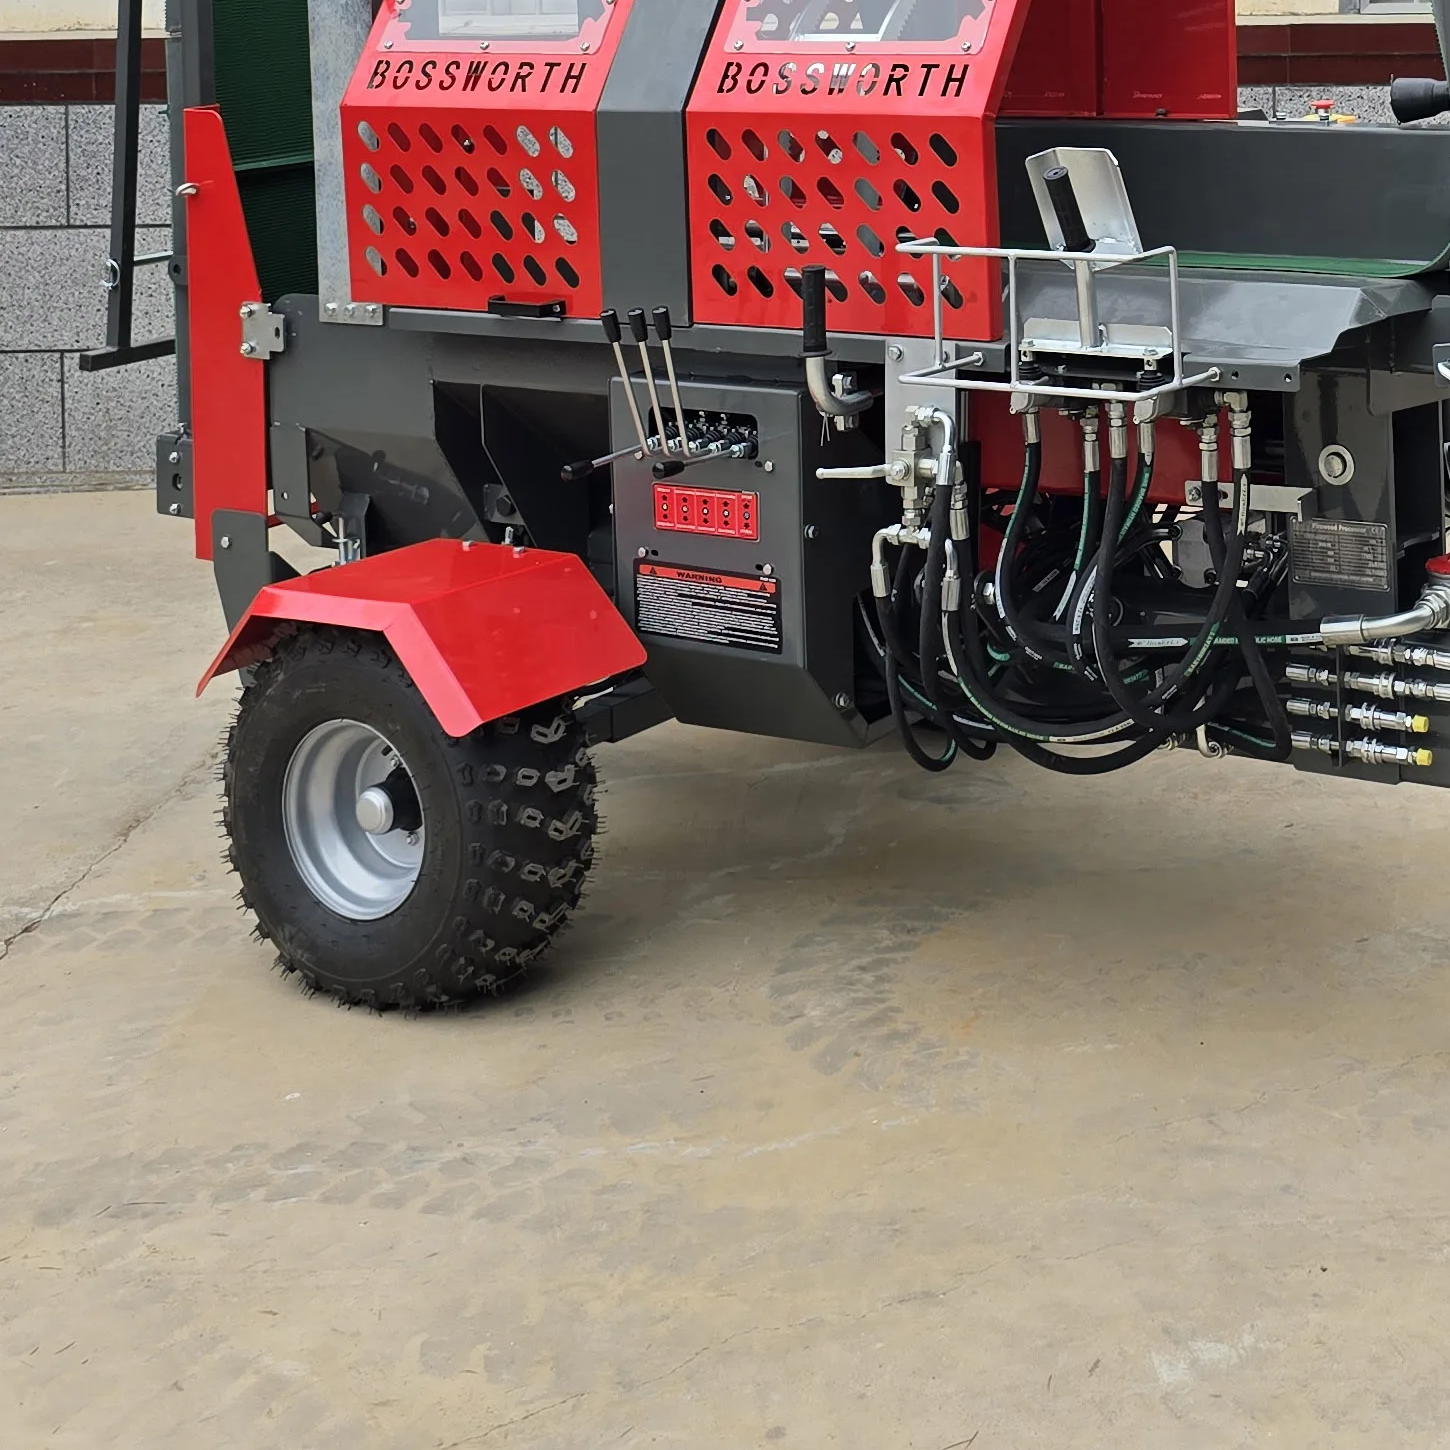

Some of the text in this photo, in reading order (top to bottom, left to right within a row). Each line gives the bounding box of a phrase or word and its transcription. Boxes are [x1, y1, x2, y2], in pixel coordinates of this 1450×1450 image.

[367, 59, 587, 94] BOSSWORTH
[717, 61, 970, 97] BOSSWORTH
[676, 570, 723, 584] WARNING
